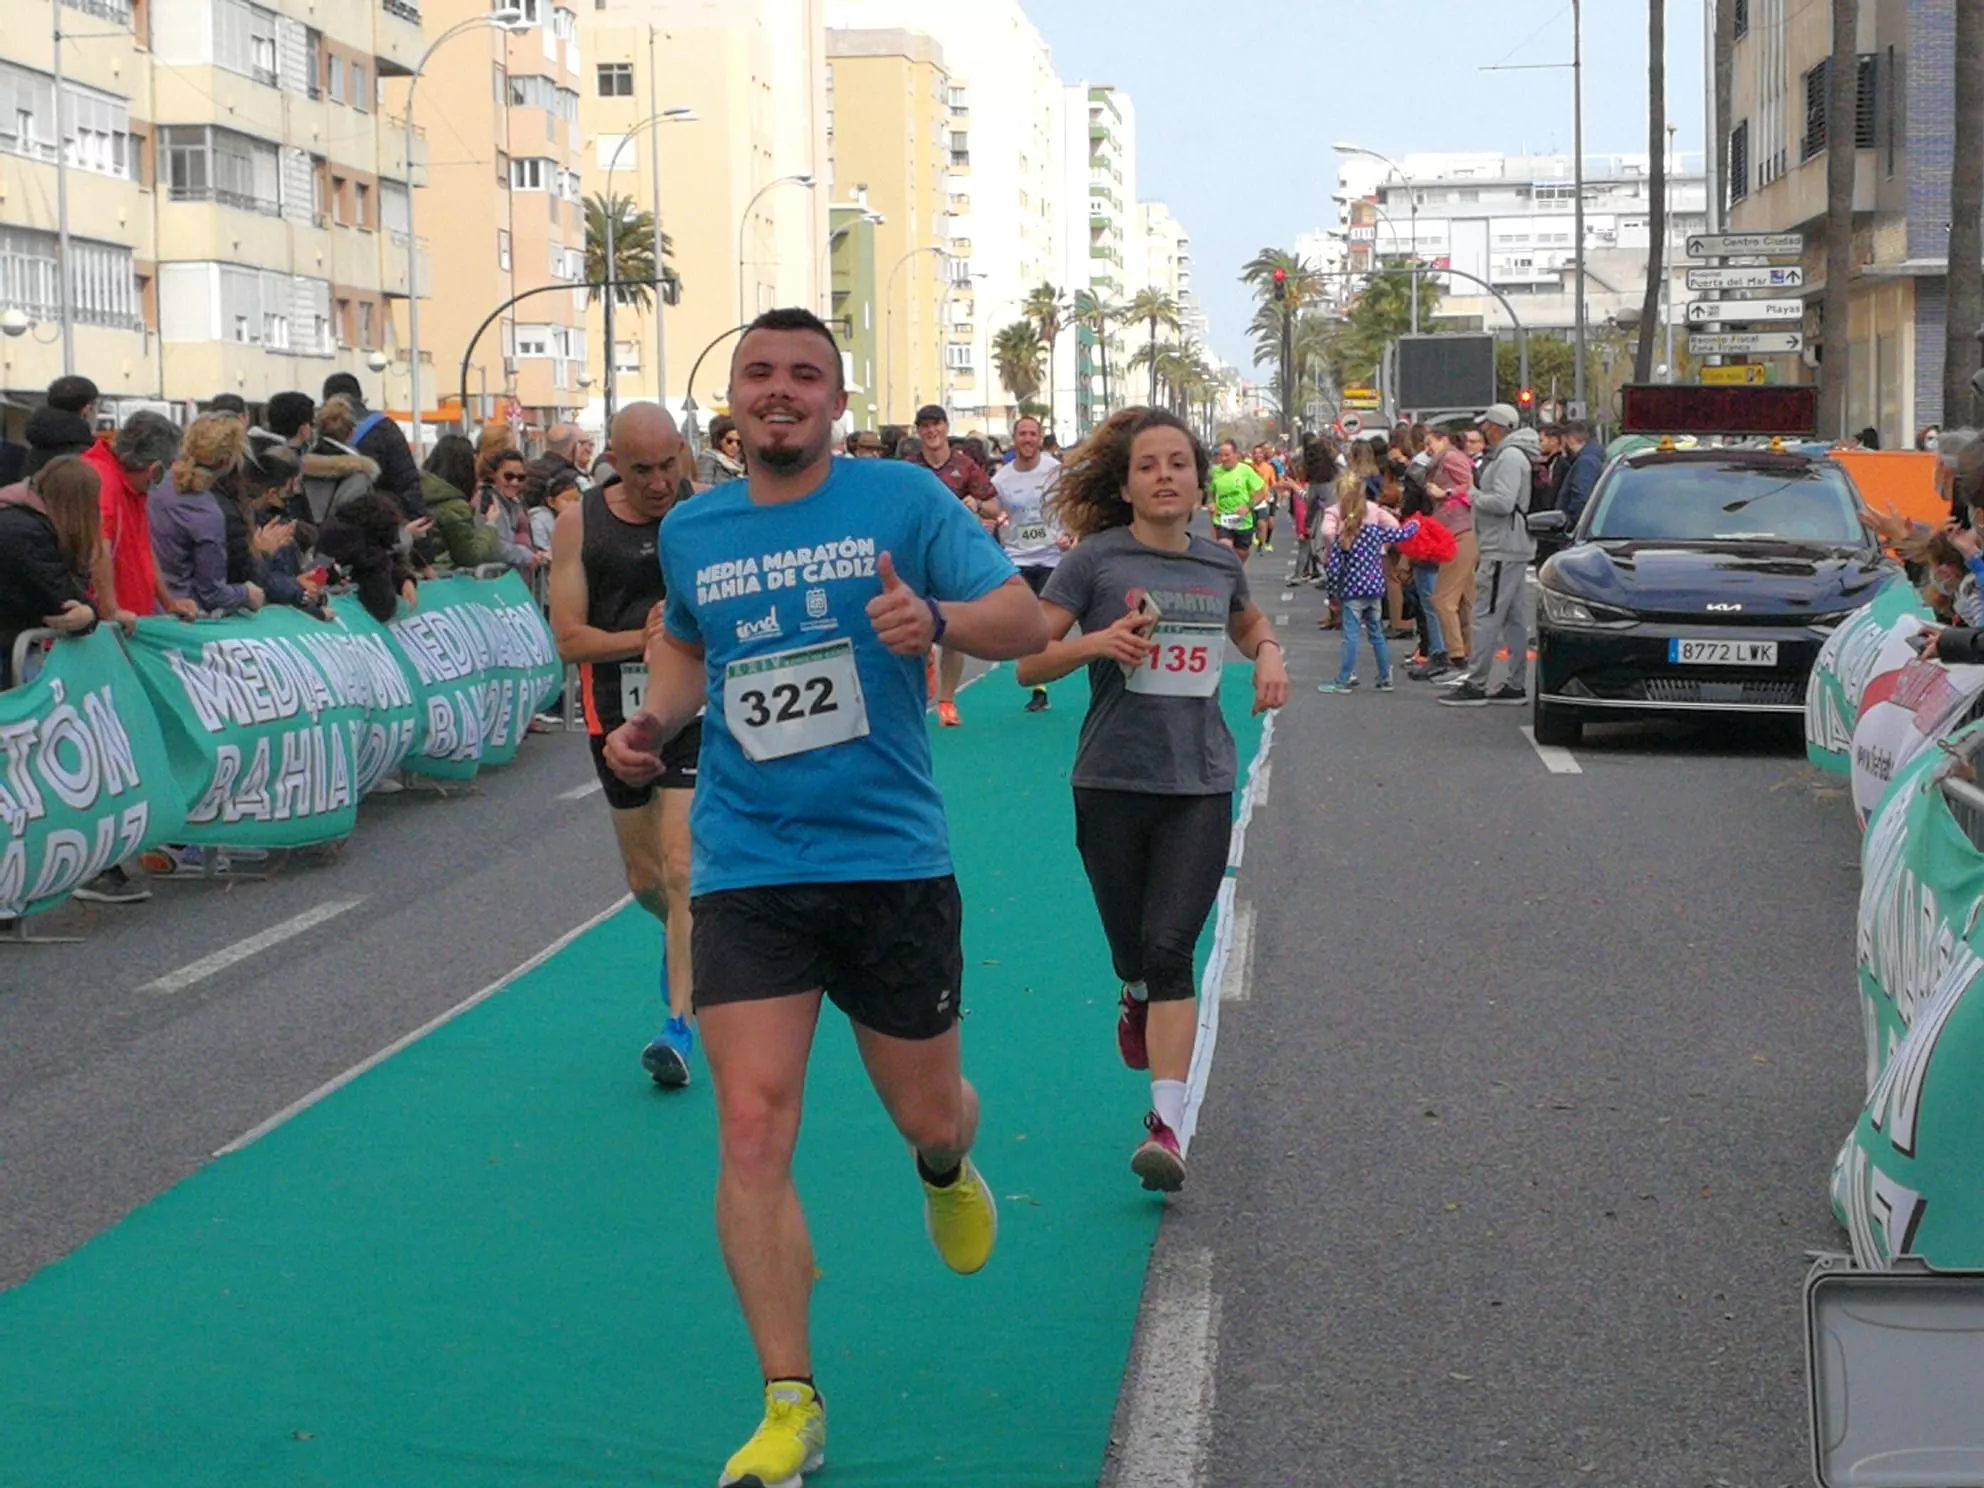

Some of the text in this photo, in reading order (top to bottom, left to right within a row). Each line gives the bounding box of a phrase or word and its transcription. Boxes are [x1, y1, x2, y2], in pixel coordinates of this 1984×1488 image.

[1747, 277, 1768, 286] Mar
[1765, 304, 1801, 315] Playas
[696, 536, 876, 586] MEDIA MARATÓN
[767, 568, 797, 590] DE
[1706, 603, 1742, 612] KIA
[1148, 643, 1209, 674] 135
[1683, 643, 1773, 662] 8772 LWK
[161, 634, 337, 733] MEDIA
[740, 676, 839, 728] 322
